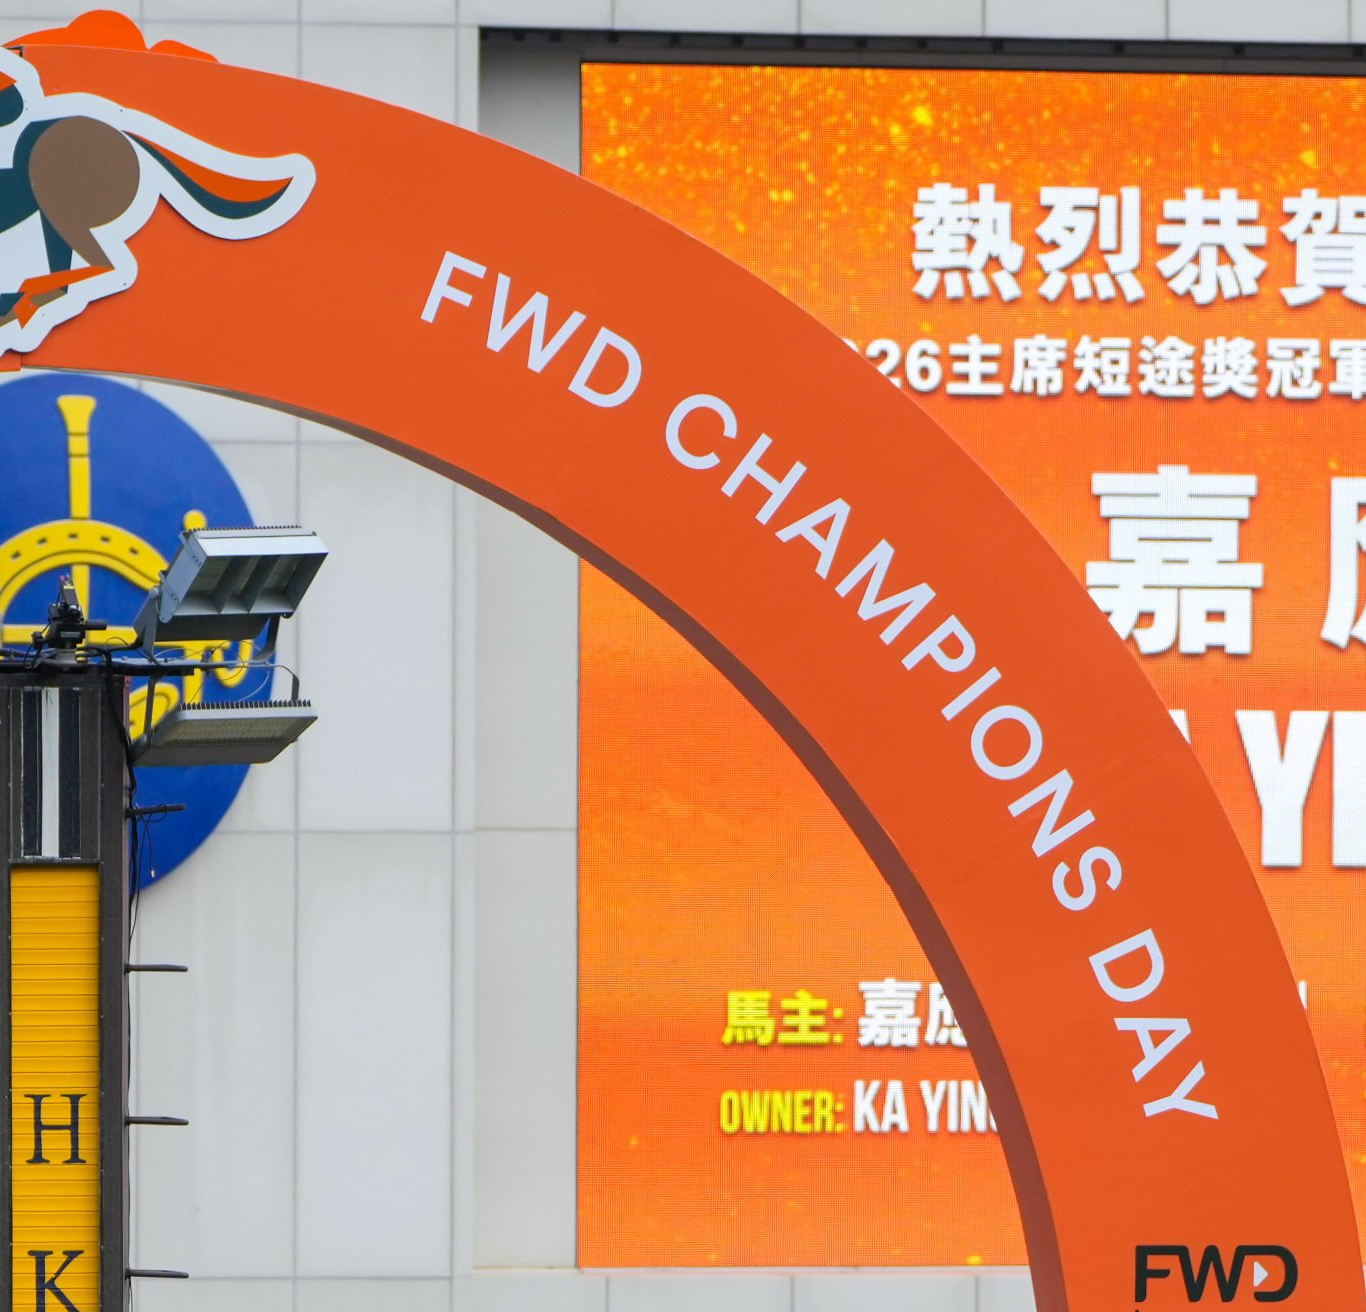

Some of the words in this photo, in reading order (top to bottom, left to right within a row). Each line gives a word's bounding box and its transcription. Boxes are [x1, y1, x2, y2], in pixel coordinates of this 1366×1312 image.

[421, 252, 641, 407] FWD
[666, 395, 1122, 910] CHAMPIONS
[1089, 929, 1218, 1119] DAY
[720, 1090, 845, 1134] OWNER:
[854, 1080, 909, 1133] KA
[920, 1080, 997, 1133] YIN
[1134, 1243, 1300, 1303] FWD
